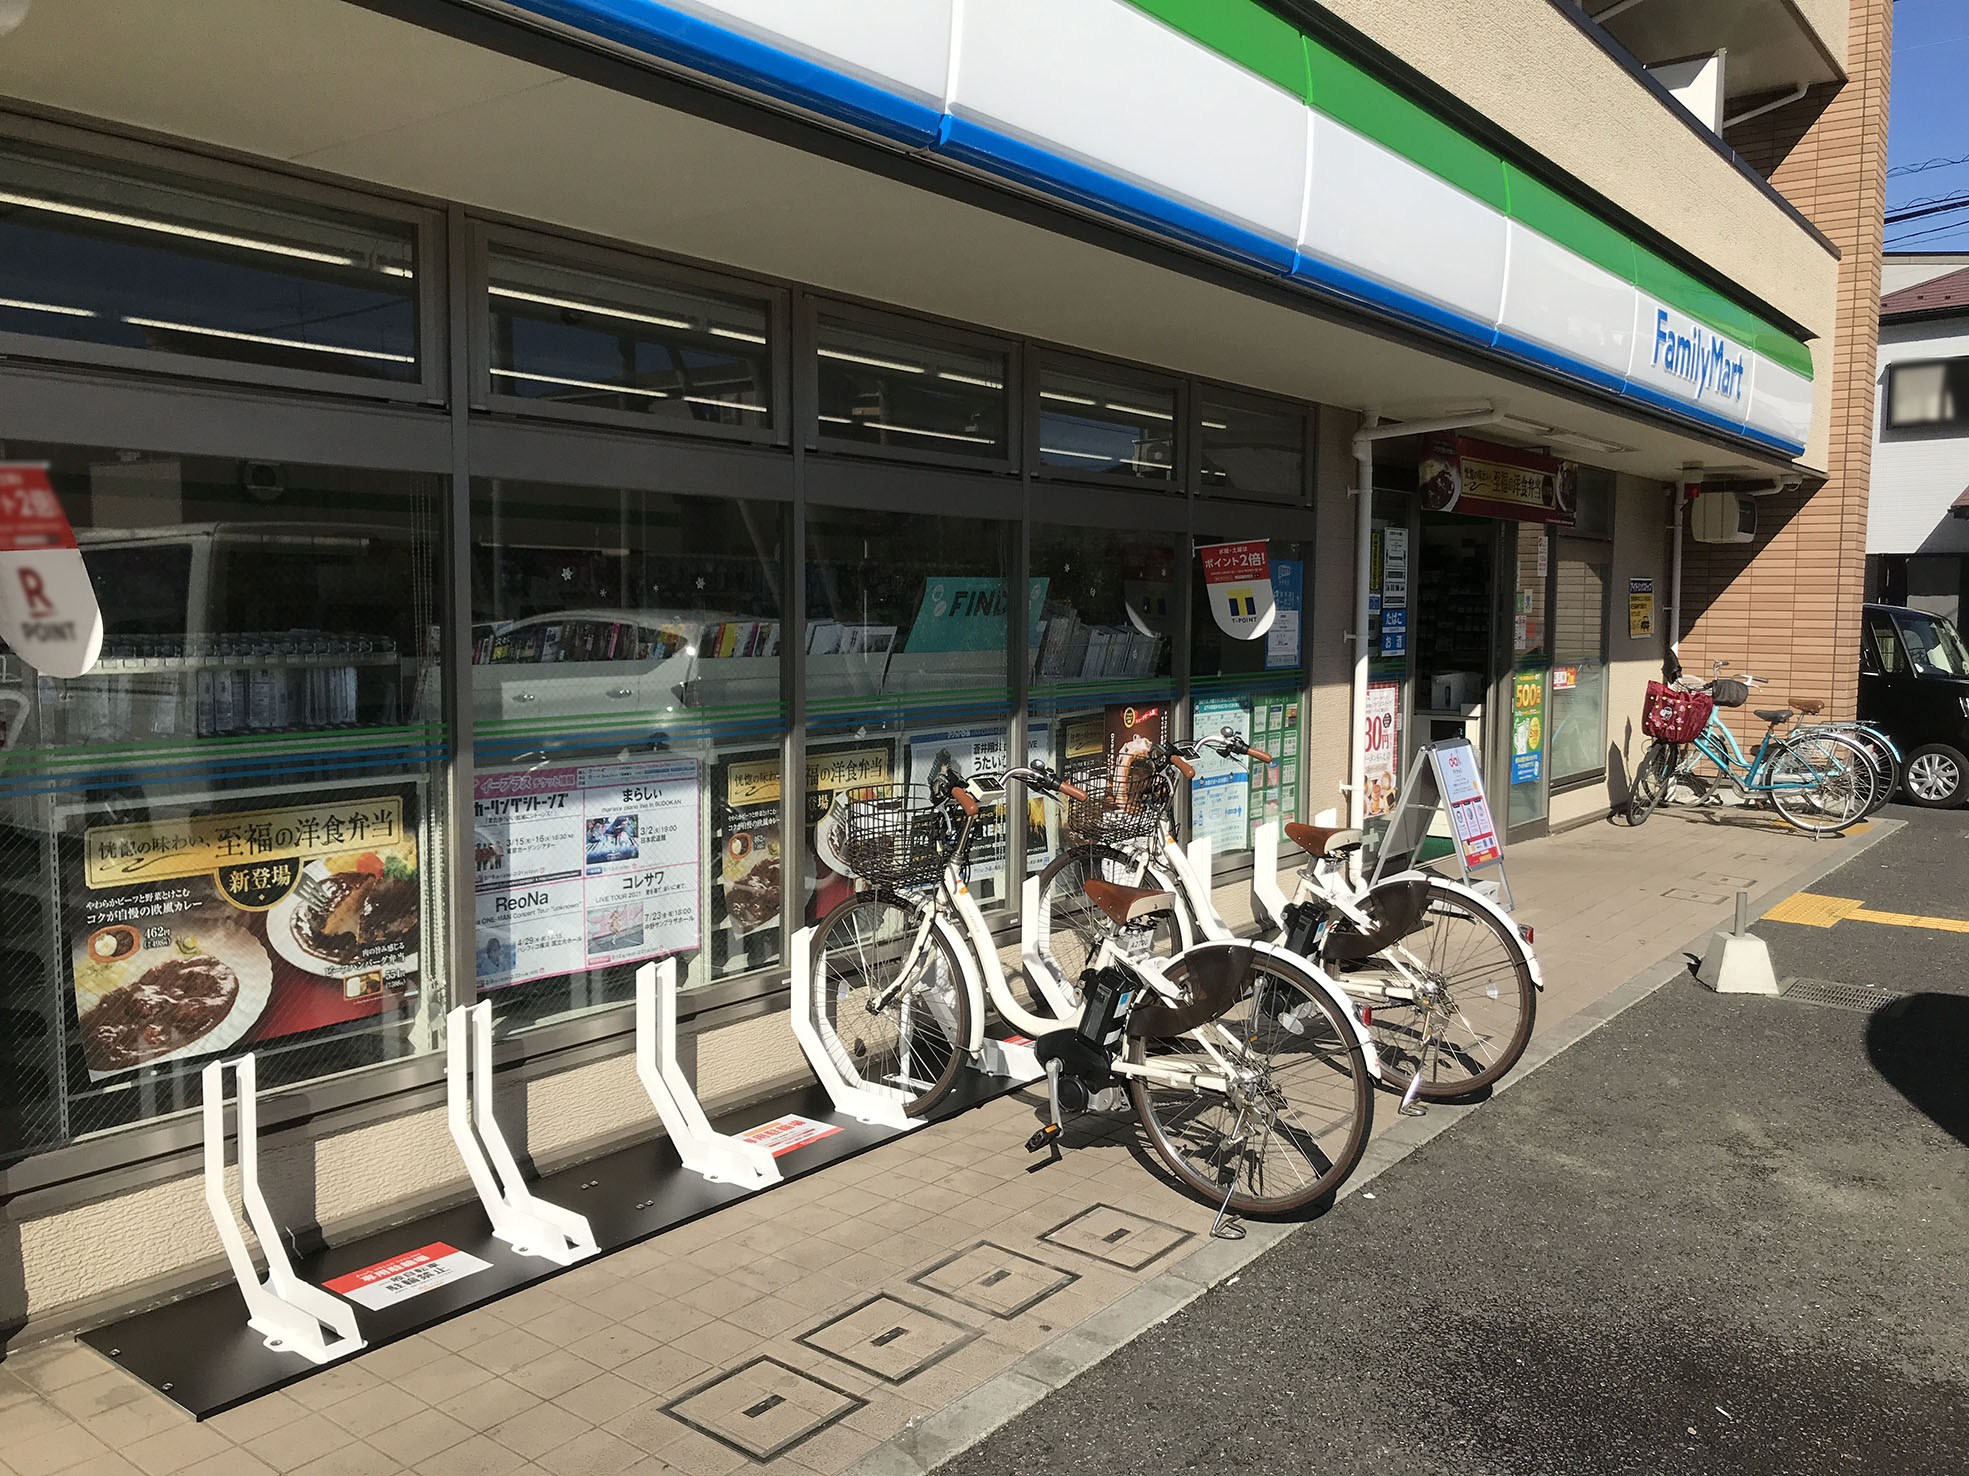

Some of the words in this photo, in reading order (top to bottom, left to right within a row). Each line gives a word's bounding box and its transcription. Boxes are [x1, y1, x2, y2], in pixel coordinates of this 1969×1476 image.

[1652, 308, 1744, 400] FamilyMart
[1204, 552, 1266, 569] ポイント2倍!
[21, 622, 76, 641] POINT
[480, 775, 532, 794] イープラス
[622, 787, 662, 802] まらしい
[655, 799, 682, 808] BUDOKAN
[640, 834, 666, 844] 日本武道館
[229, 864, 292, 894] 新登場
[622, 871, 664, 889] コレサワ
[86, 888, 191, 911] やわらかビーフと野菜とけこむ
[495, 891, 549, 913] ReoNa
[611, 893, 627, 901] TOUR
[86, 900, 203, 924] コクが自慢の欧風カレー
[481, 914, 511, 924] ONE-MAN
